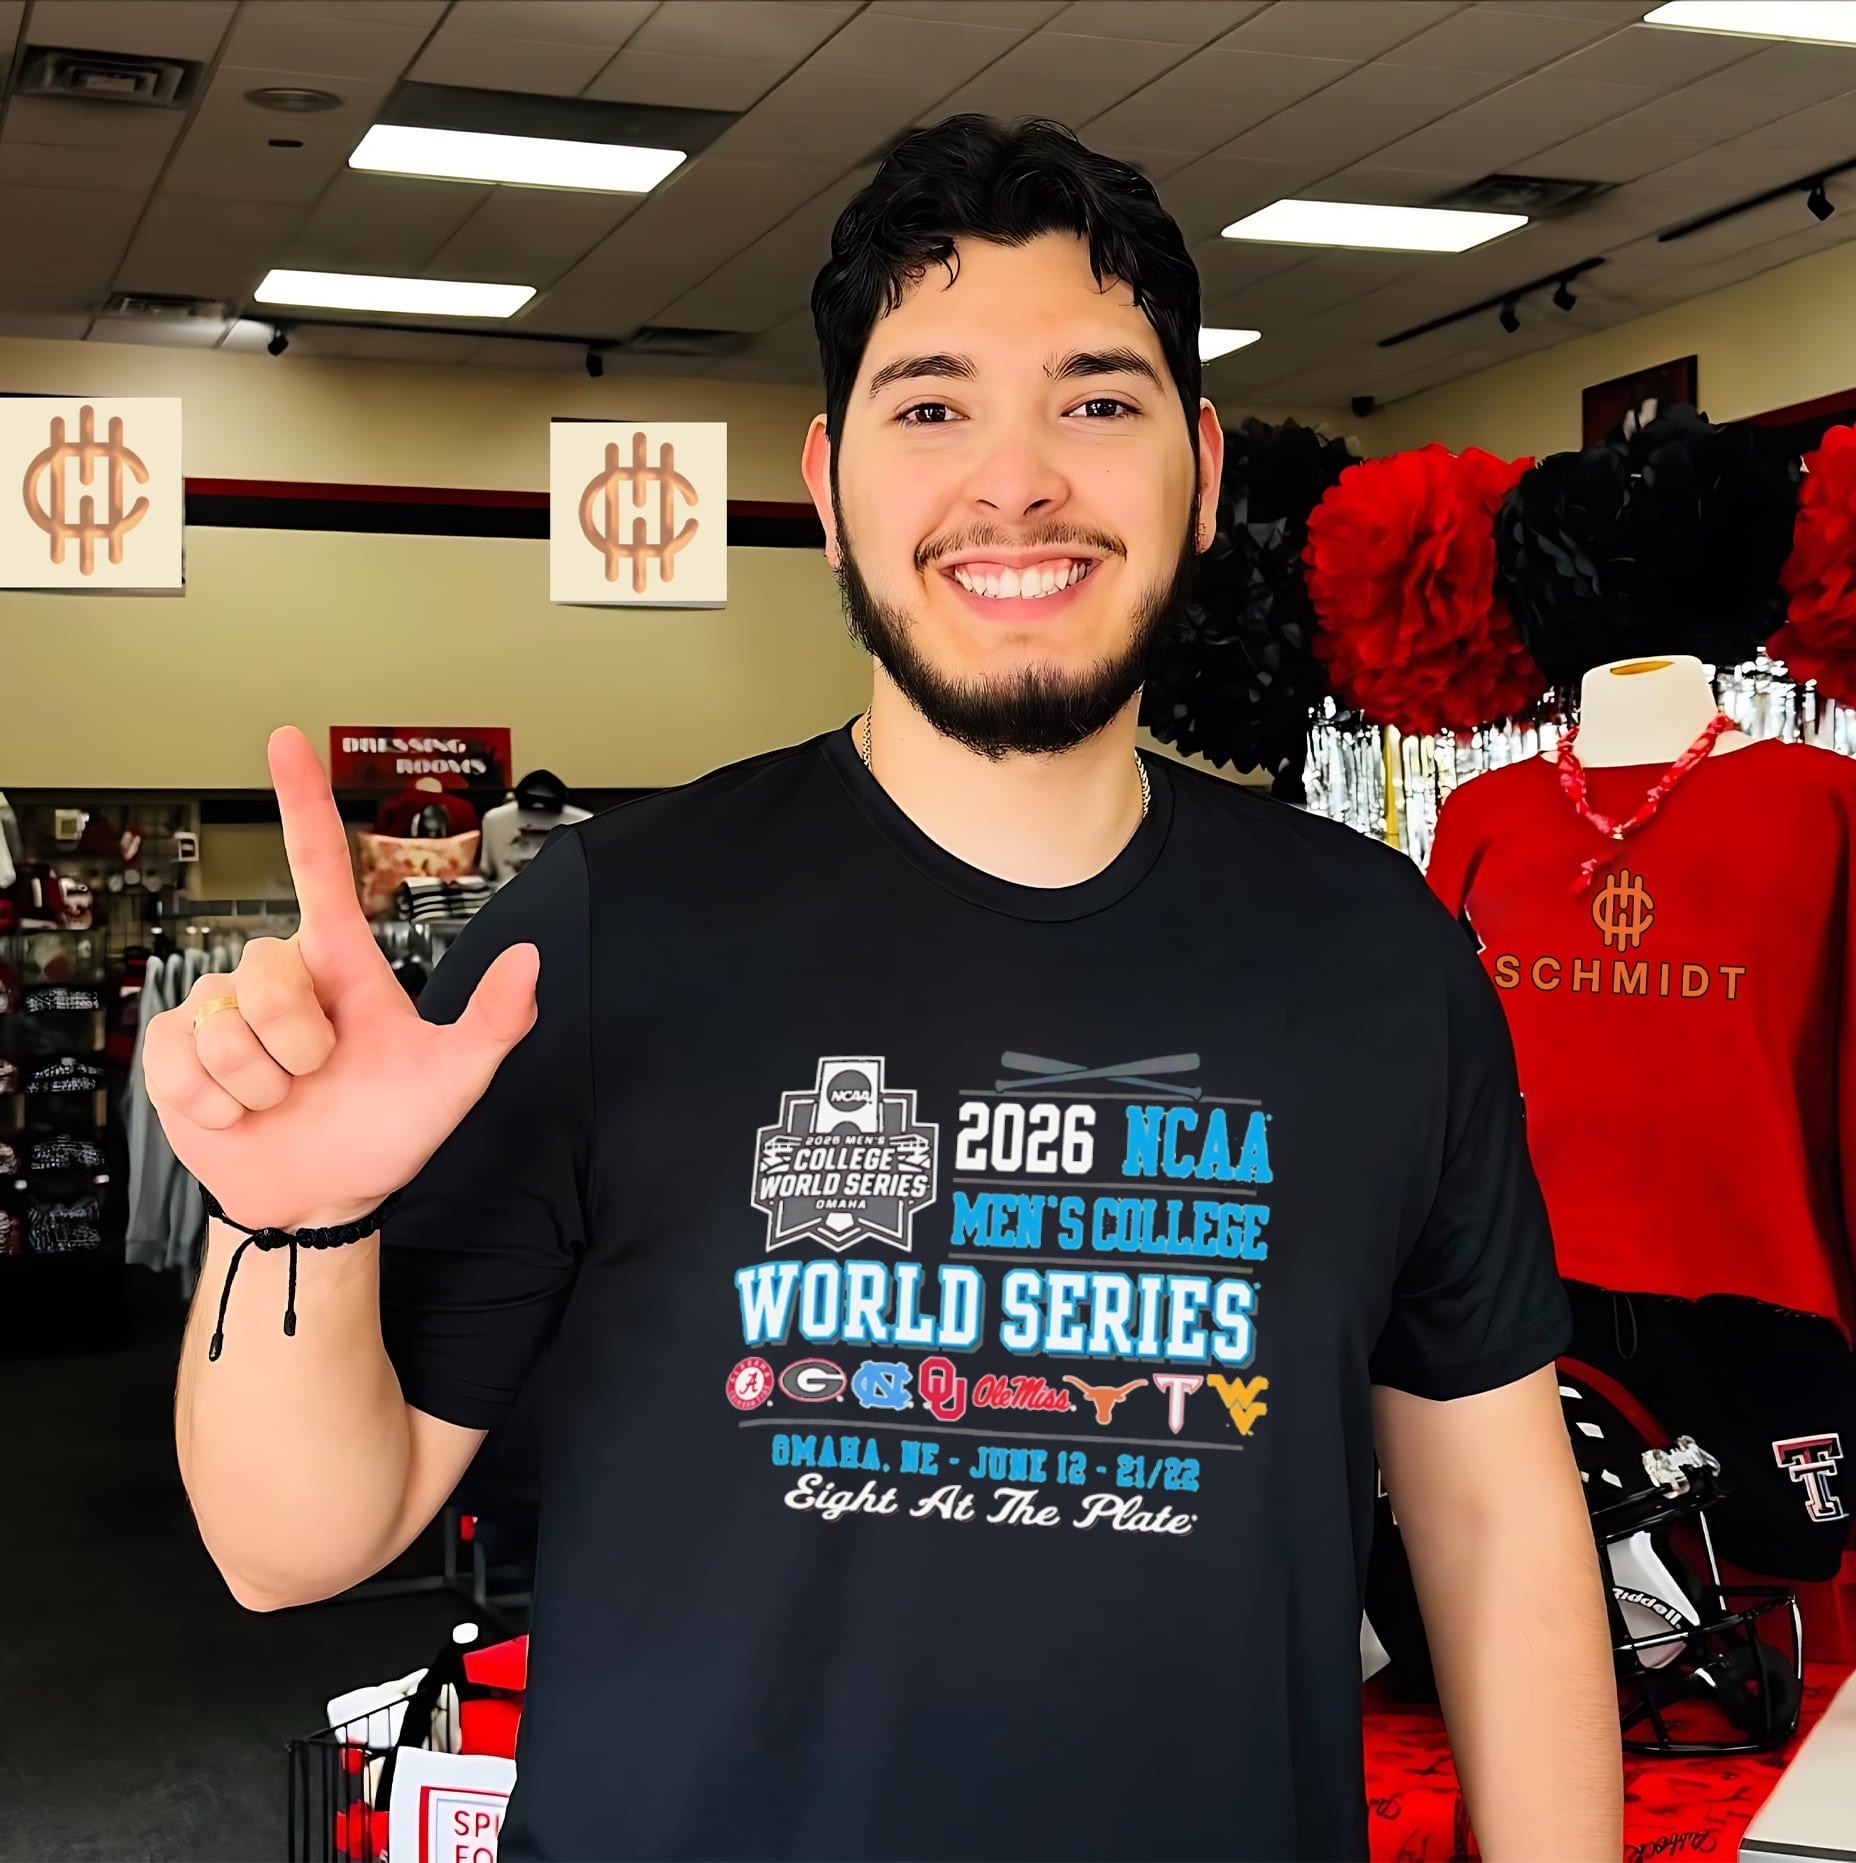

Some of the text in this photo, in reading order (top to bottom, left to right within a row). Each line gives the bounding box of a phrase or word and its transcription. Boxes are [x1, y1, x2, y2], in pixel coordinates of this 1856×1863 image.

[1494, 954, 1747, 1000] SCHMIDT
[831, 1090, 872, 1102] NCAA
[794, 1147, 895, 1171] COLLEGE
[805, 1136, 886, 1146] 2026 MEN'S
[955, 1101, 1273, 1183] 2026 NCAA
[760, 1173, 928, 1200] WORLD SERIES
[815, 1199, 867, 1209] OMAHA
[950, 1191, 1270, 1261] MEN'S COLLEGE
[735, 1260, 1257, 1367] WORLD SERIES
[900, 1440, 940, 1475] NE
[969, 1446, 1048, 1483] JUNE
[1057, 1450, 1086, 1485] 12
[1116, 1454, 1200, 1493] 21/22
[784, 1473, 1192, 1536] Eight At The Plate
